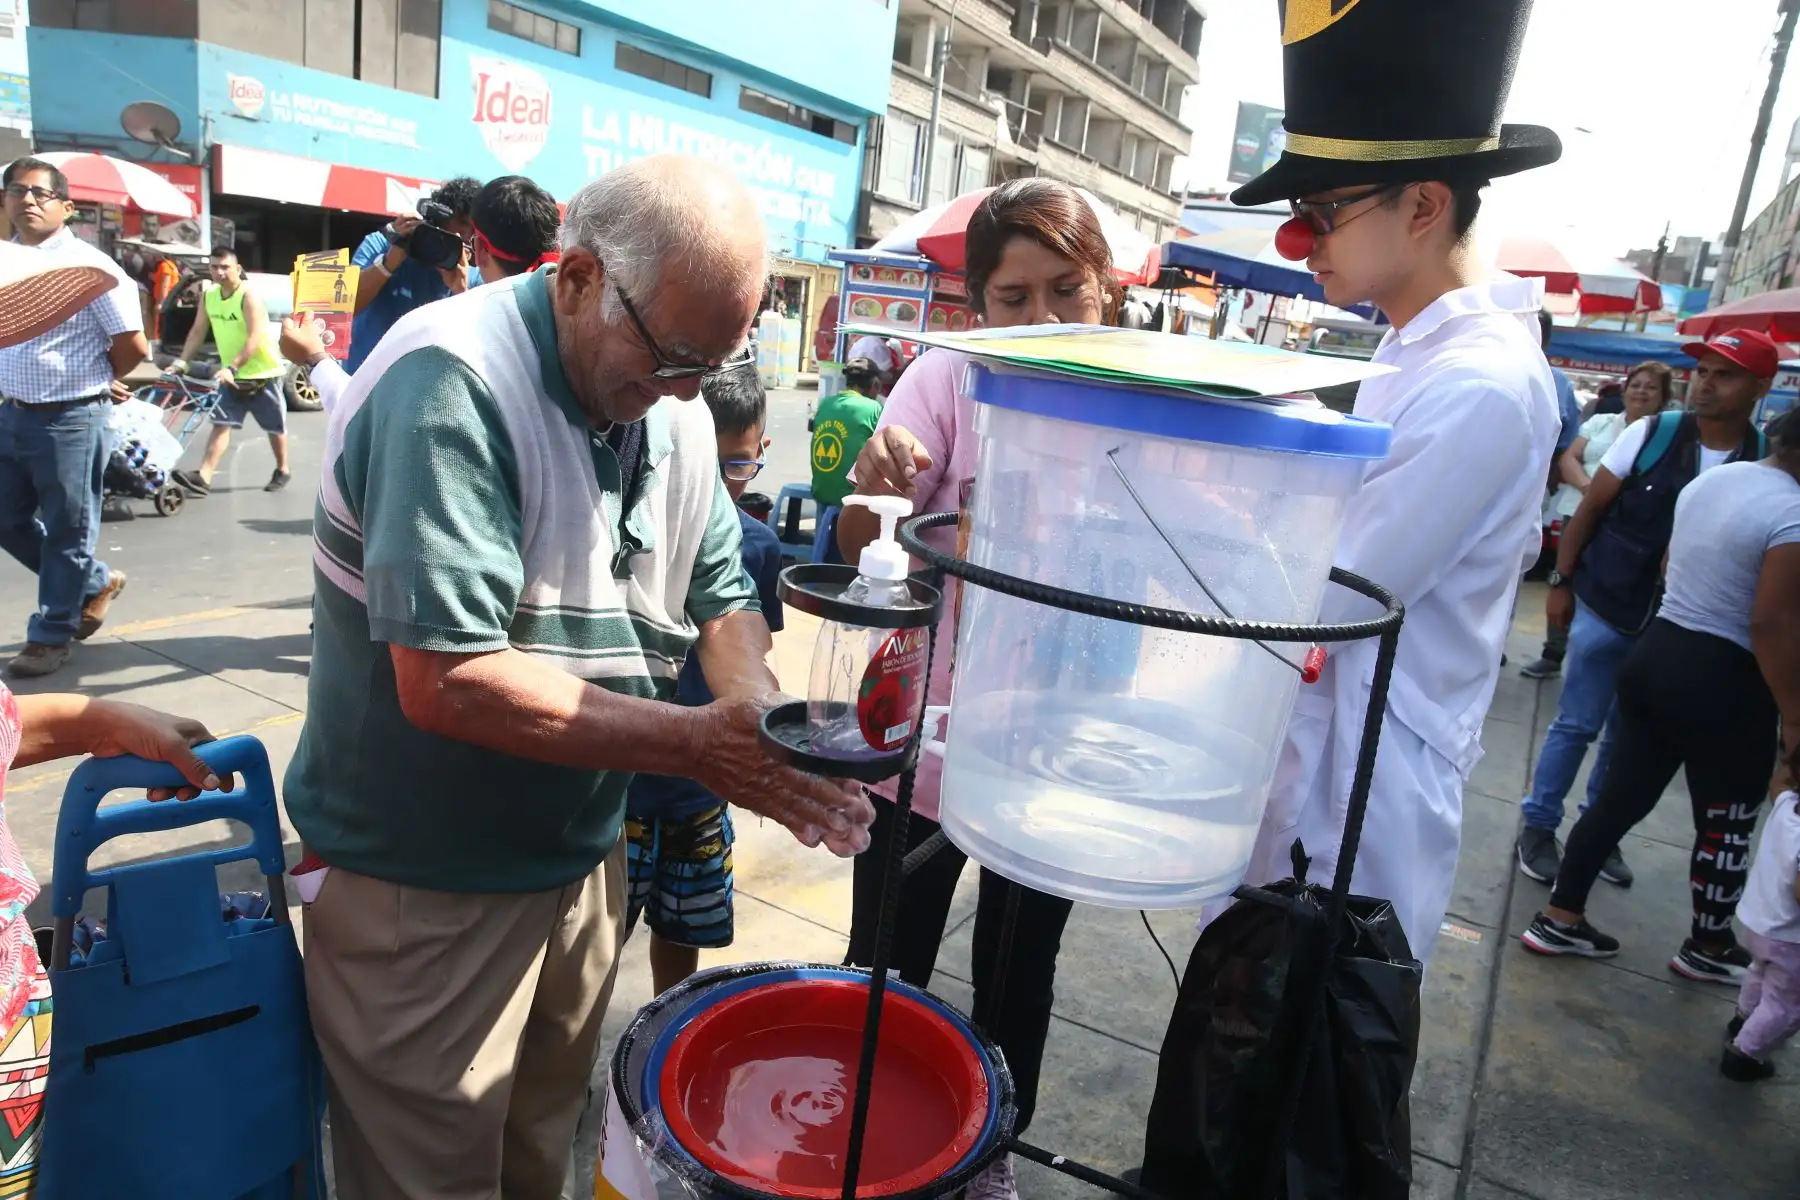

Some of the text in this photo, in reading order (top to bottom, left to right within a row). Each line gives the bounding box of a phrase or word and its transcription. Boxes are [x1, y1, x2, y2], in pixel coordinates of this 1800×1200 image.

[230, 79, 264, 99] Idea
[472, 72, 550, 126] Ideal
[581, 103, 621, 145] LA
